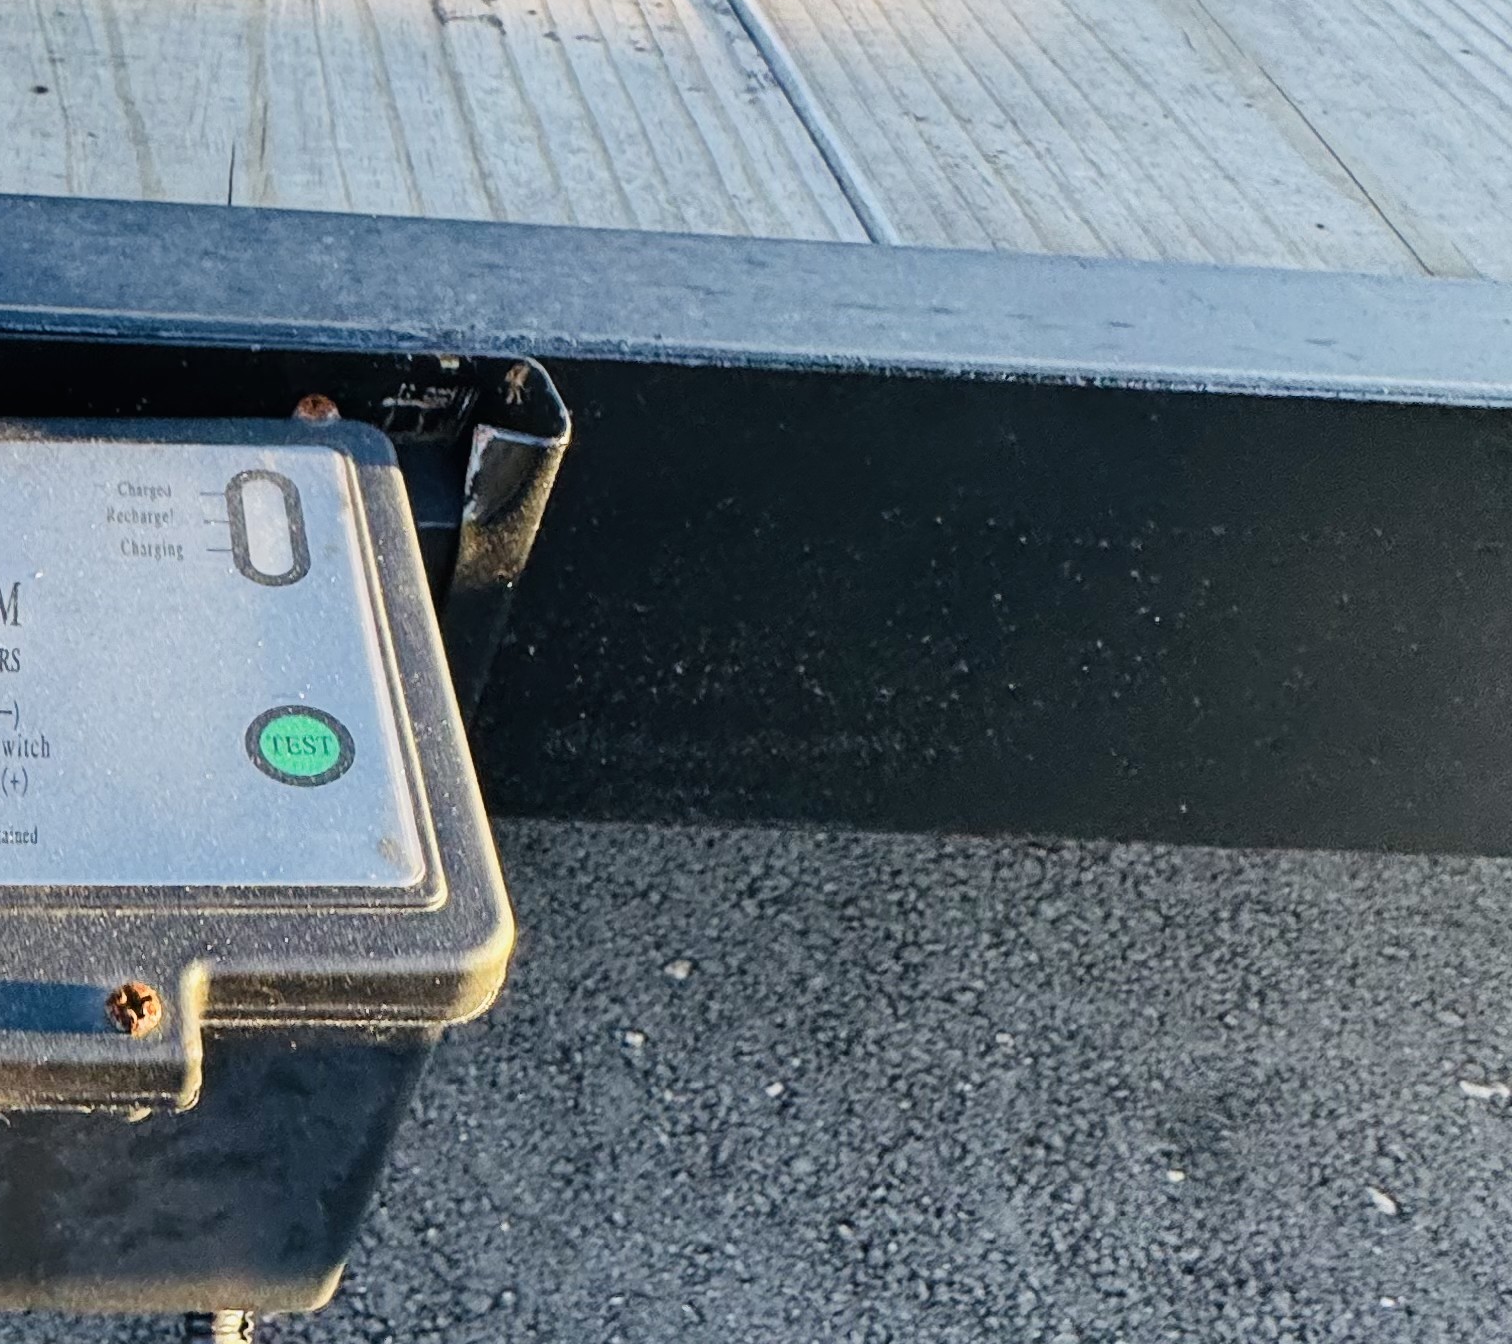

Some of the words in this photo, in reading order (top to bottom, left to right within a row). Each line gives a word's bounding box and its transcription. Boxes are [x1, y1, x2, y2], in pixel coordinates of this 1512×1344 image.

[117, 481, 172, 504] Charged
[120, 537, 185, 560] Charging
[266, 735, 332, 756] TEST
[0, 767, 29, 797] (+)
